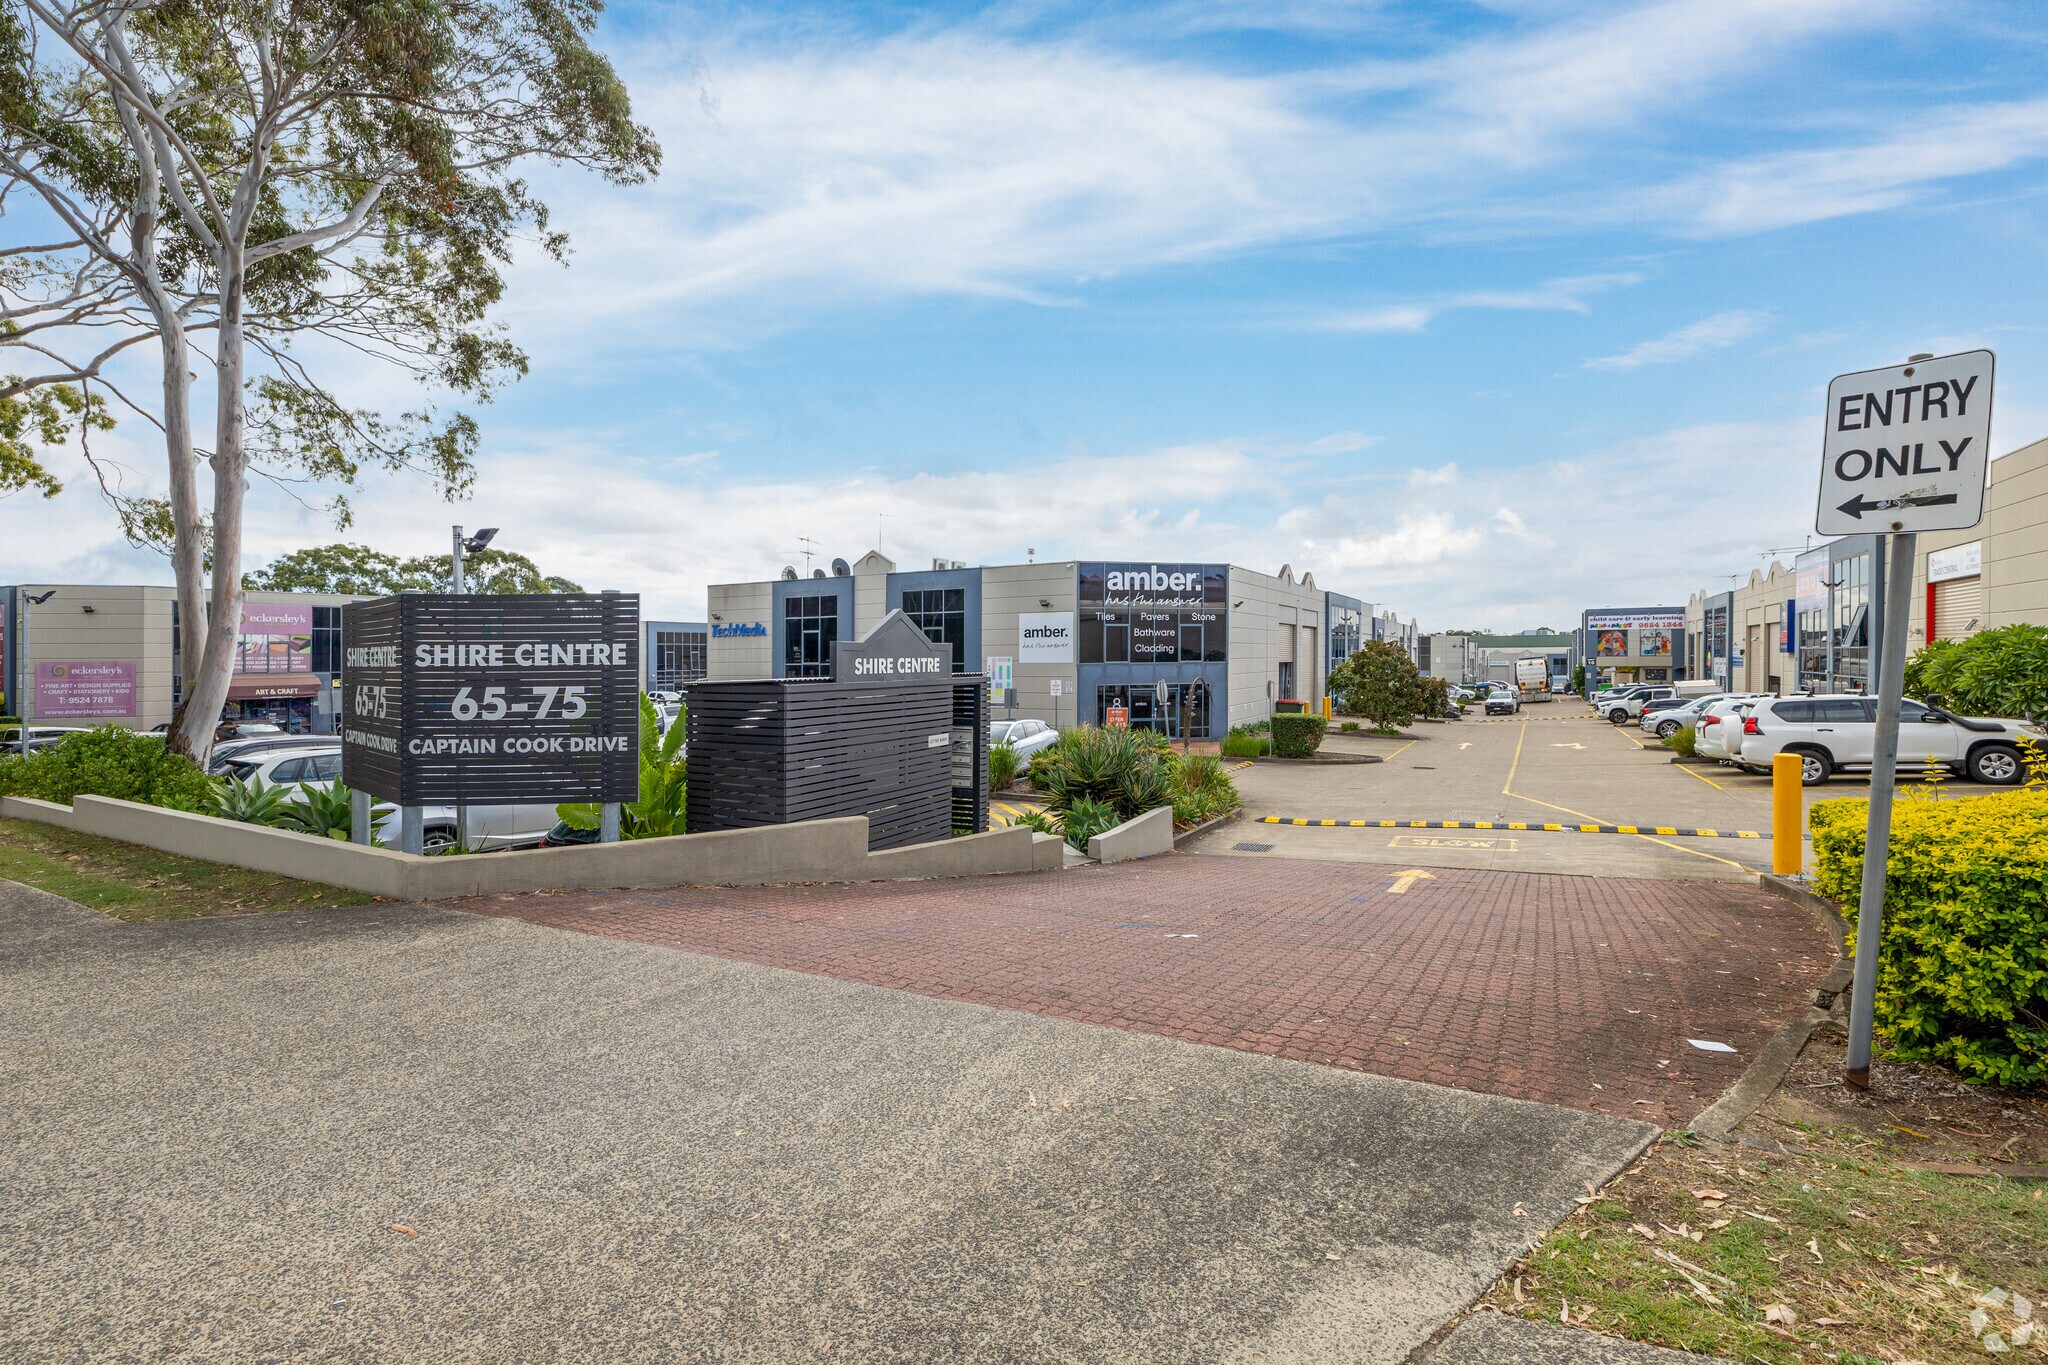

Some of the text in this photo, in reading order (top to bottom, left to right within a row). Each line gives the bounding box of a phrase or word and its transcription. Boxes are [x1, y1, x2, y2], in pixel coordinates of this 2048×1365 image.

[1838, 376, 1978, 431] ENTRY
[1835, 437, 1973, 481] ONLY
[1107, 565, 1201, 591] amber.
[1105, 592, 1203, 606] has the answer
[250, 614, 306, 625] eckersley's
[1096, 612, 1216, 620] Tiles Pavers Stone
[712, 622, 766, 637] TechMedia
[1024, 625, 1068, 638] amber.
[1134, 628, 1176, 637] Bathware
[347, 646, 397, 668] SHIRE CENTRE
[415, 644, 627, 667] SHIRE CENTRE
[1135, 644, 1174, 654] Cladding
[72, 666, 122, 676] eckersley's
[854, 658, 940, 675] SHIRE CENTRE
[355, 686, 386, 719] 65-75
[451, 686, 586, 720] 65-75
[345, 729, 397, 753] CAPTAIN COOK DRIVE
[409, 736, 628, 754] CAPTAIN COOK DRIVE
[1412, 839, 1495, 848] SLOW
